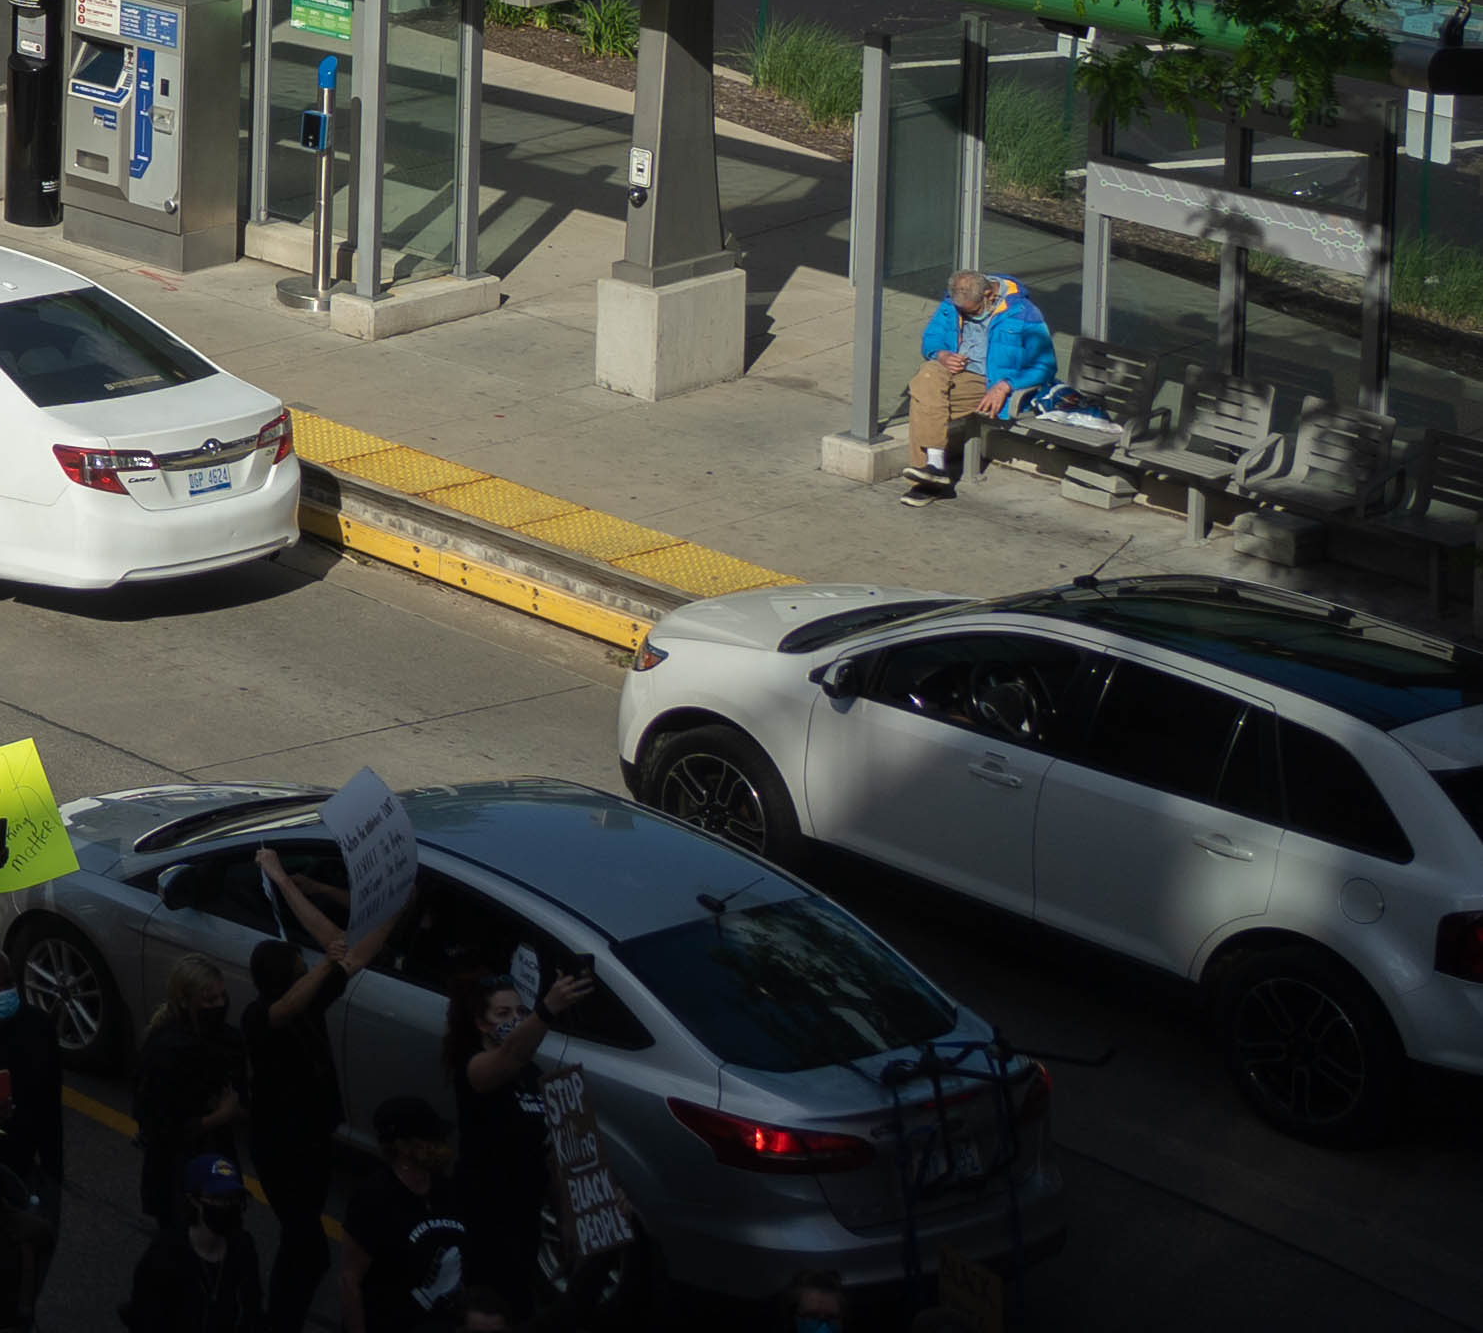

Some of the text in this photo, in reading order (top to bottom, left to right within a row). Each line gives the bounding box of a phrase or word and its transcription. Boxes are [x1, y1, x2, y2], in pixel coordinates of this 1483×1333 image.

[544, 1071, 586, 1125] STOP
[568, 1167, 615, 1217] BLACK
[574, 1207, 634, 1255] PEOPLE
